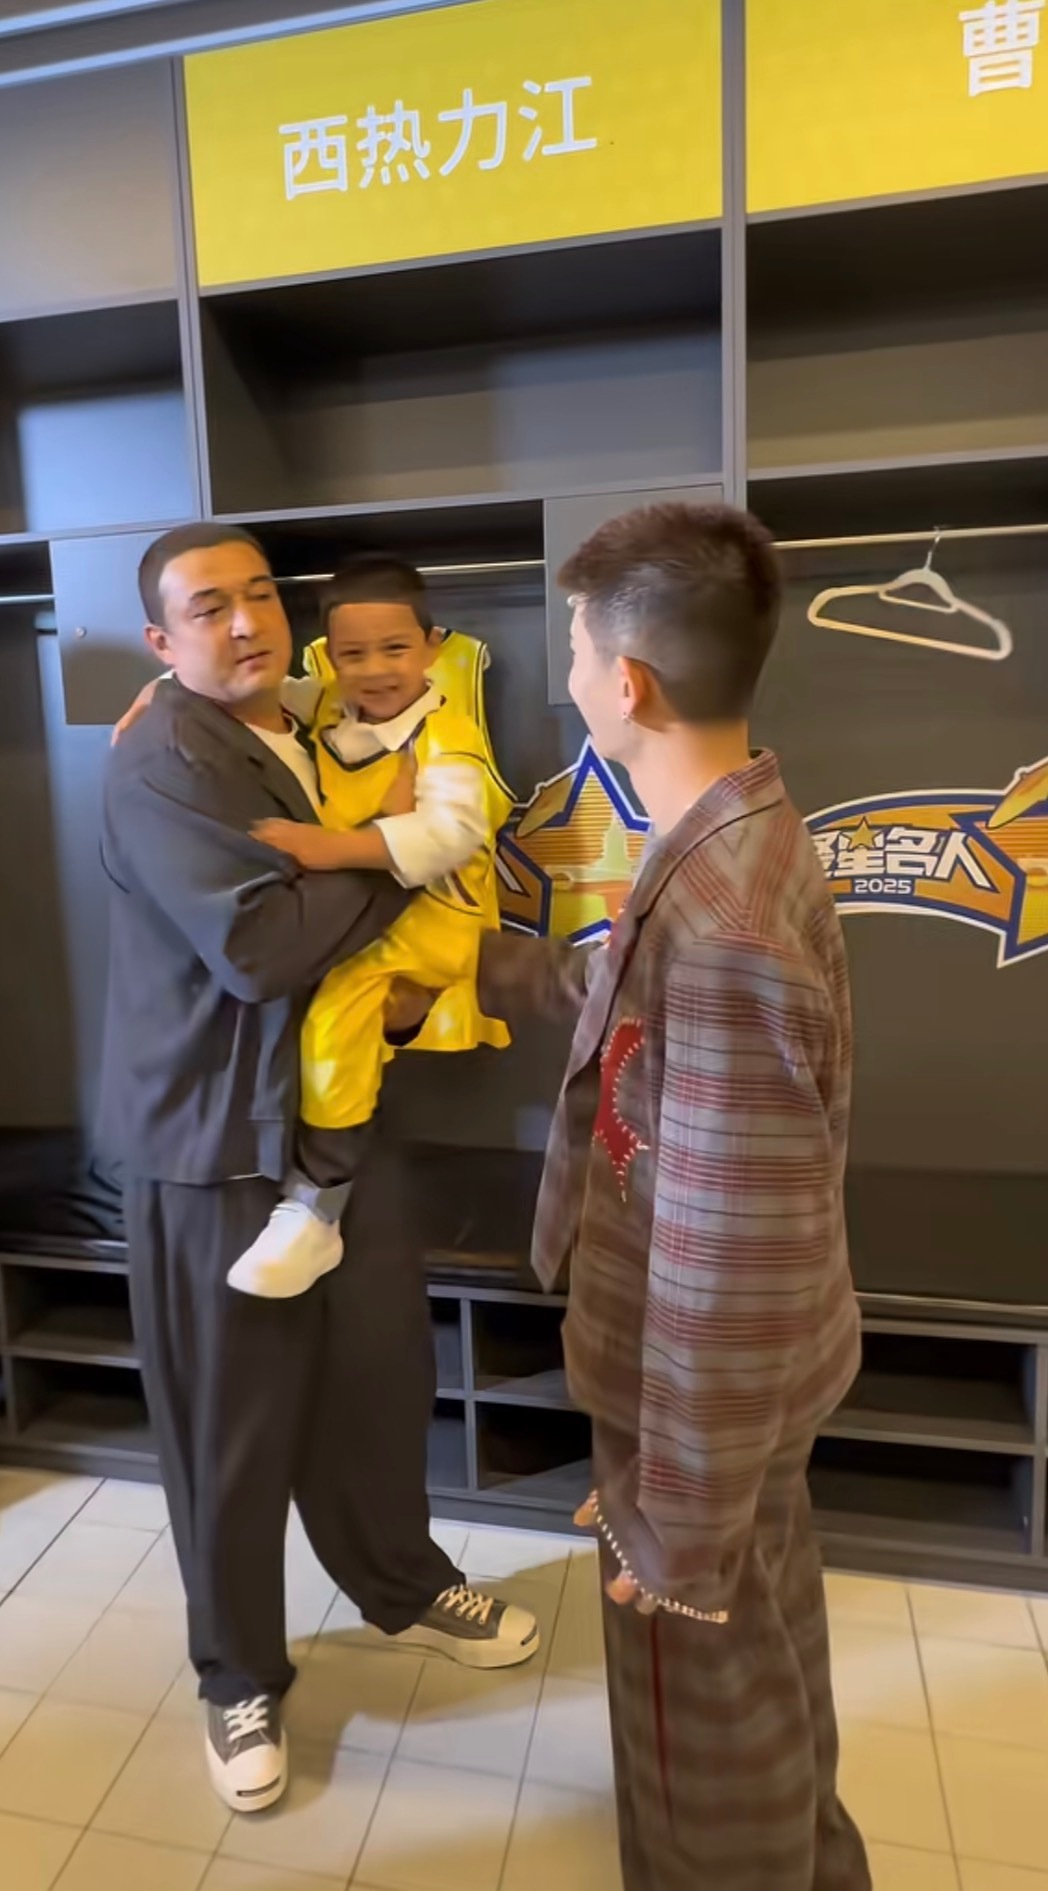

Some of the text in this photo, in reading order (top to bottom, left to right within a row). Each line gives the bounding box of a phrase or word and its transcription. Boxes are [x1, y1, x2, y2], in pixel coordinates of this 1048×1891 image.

[959, 0, 1045, 97] 曹
[278, 76, 597, 200] 西热力江
[854, 878, 912, 895] 2025
